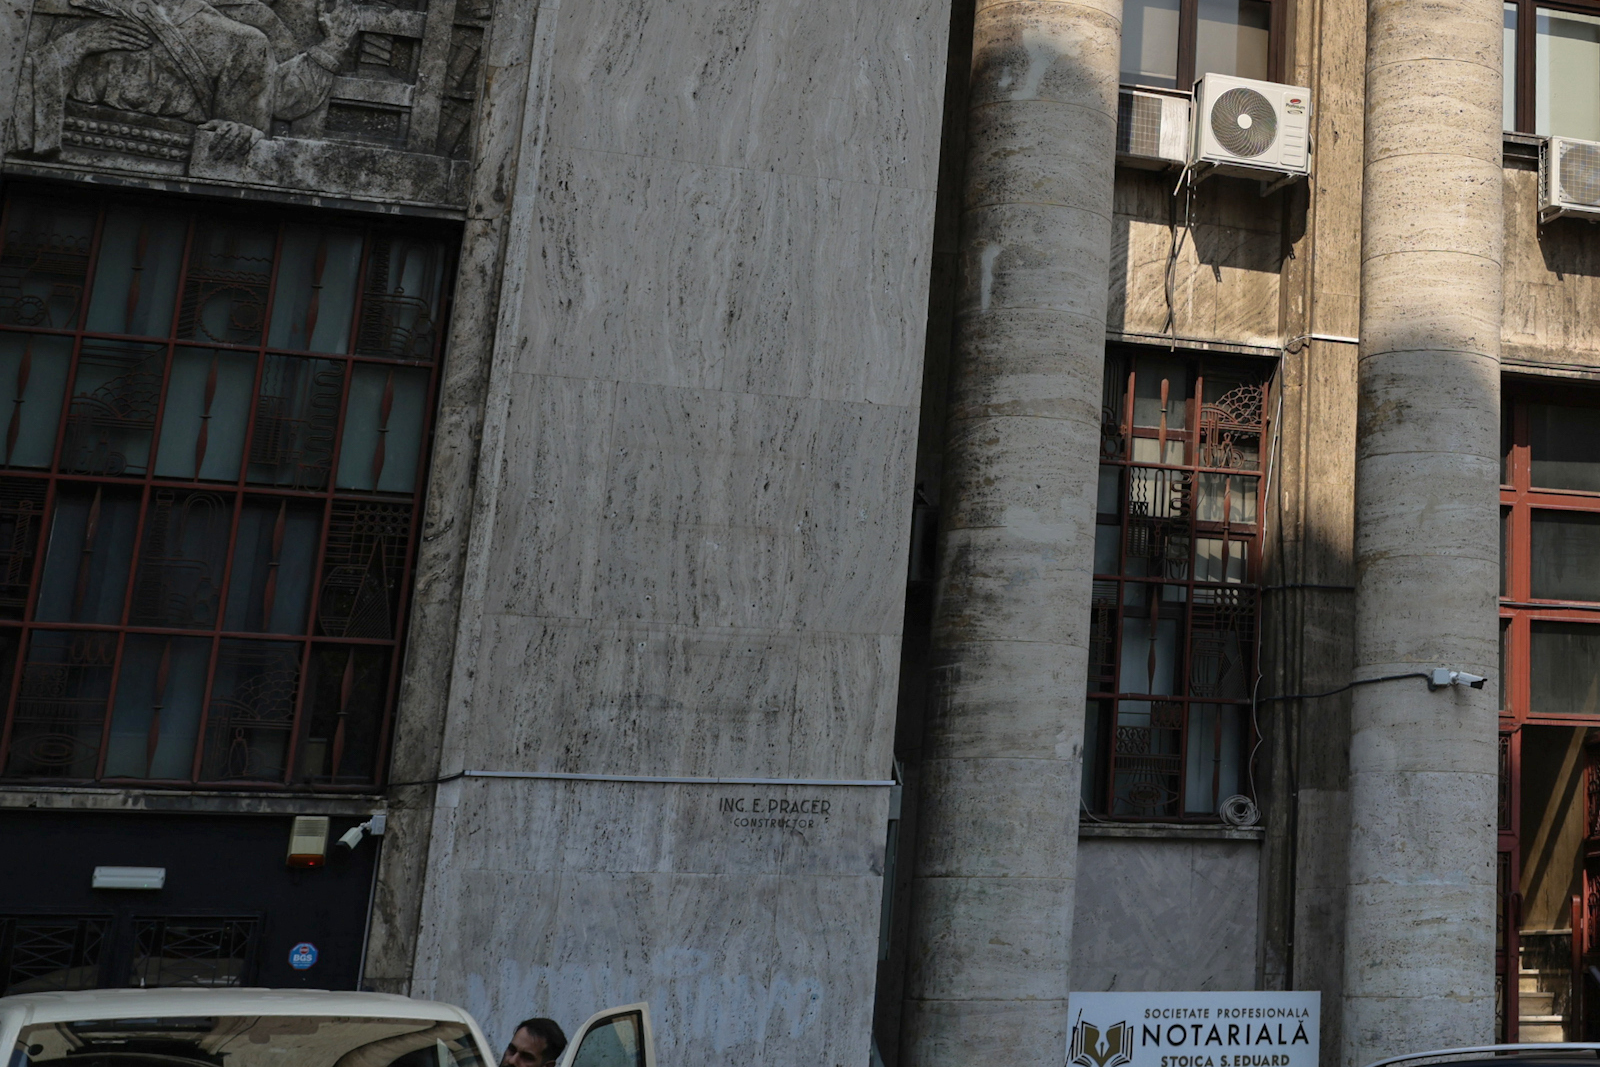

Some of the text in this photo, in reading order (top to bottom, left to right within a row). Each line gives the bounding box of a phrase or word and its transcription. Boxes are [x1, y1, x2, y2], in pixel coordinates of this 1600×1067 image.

[733, 817, 815, 829] CONSTRUCTOR
[292, 953, 313, 962] BGS
[1144, 1008, 1210, 1019] SOCIETATE
[1142, 1019, 1310, 1047] NOTARIALĂ
[1160, 1053, 1290, 1067] STOICA S.EDUARD
